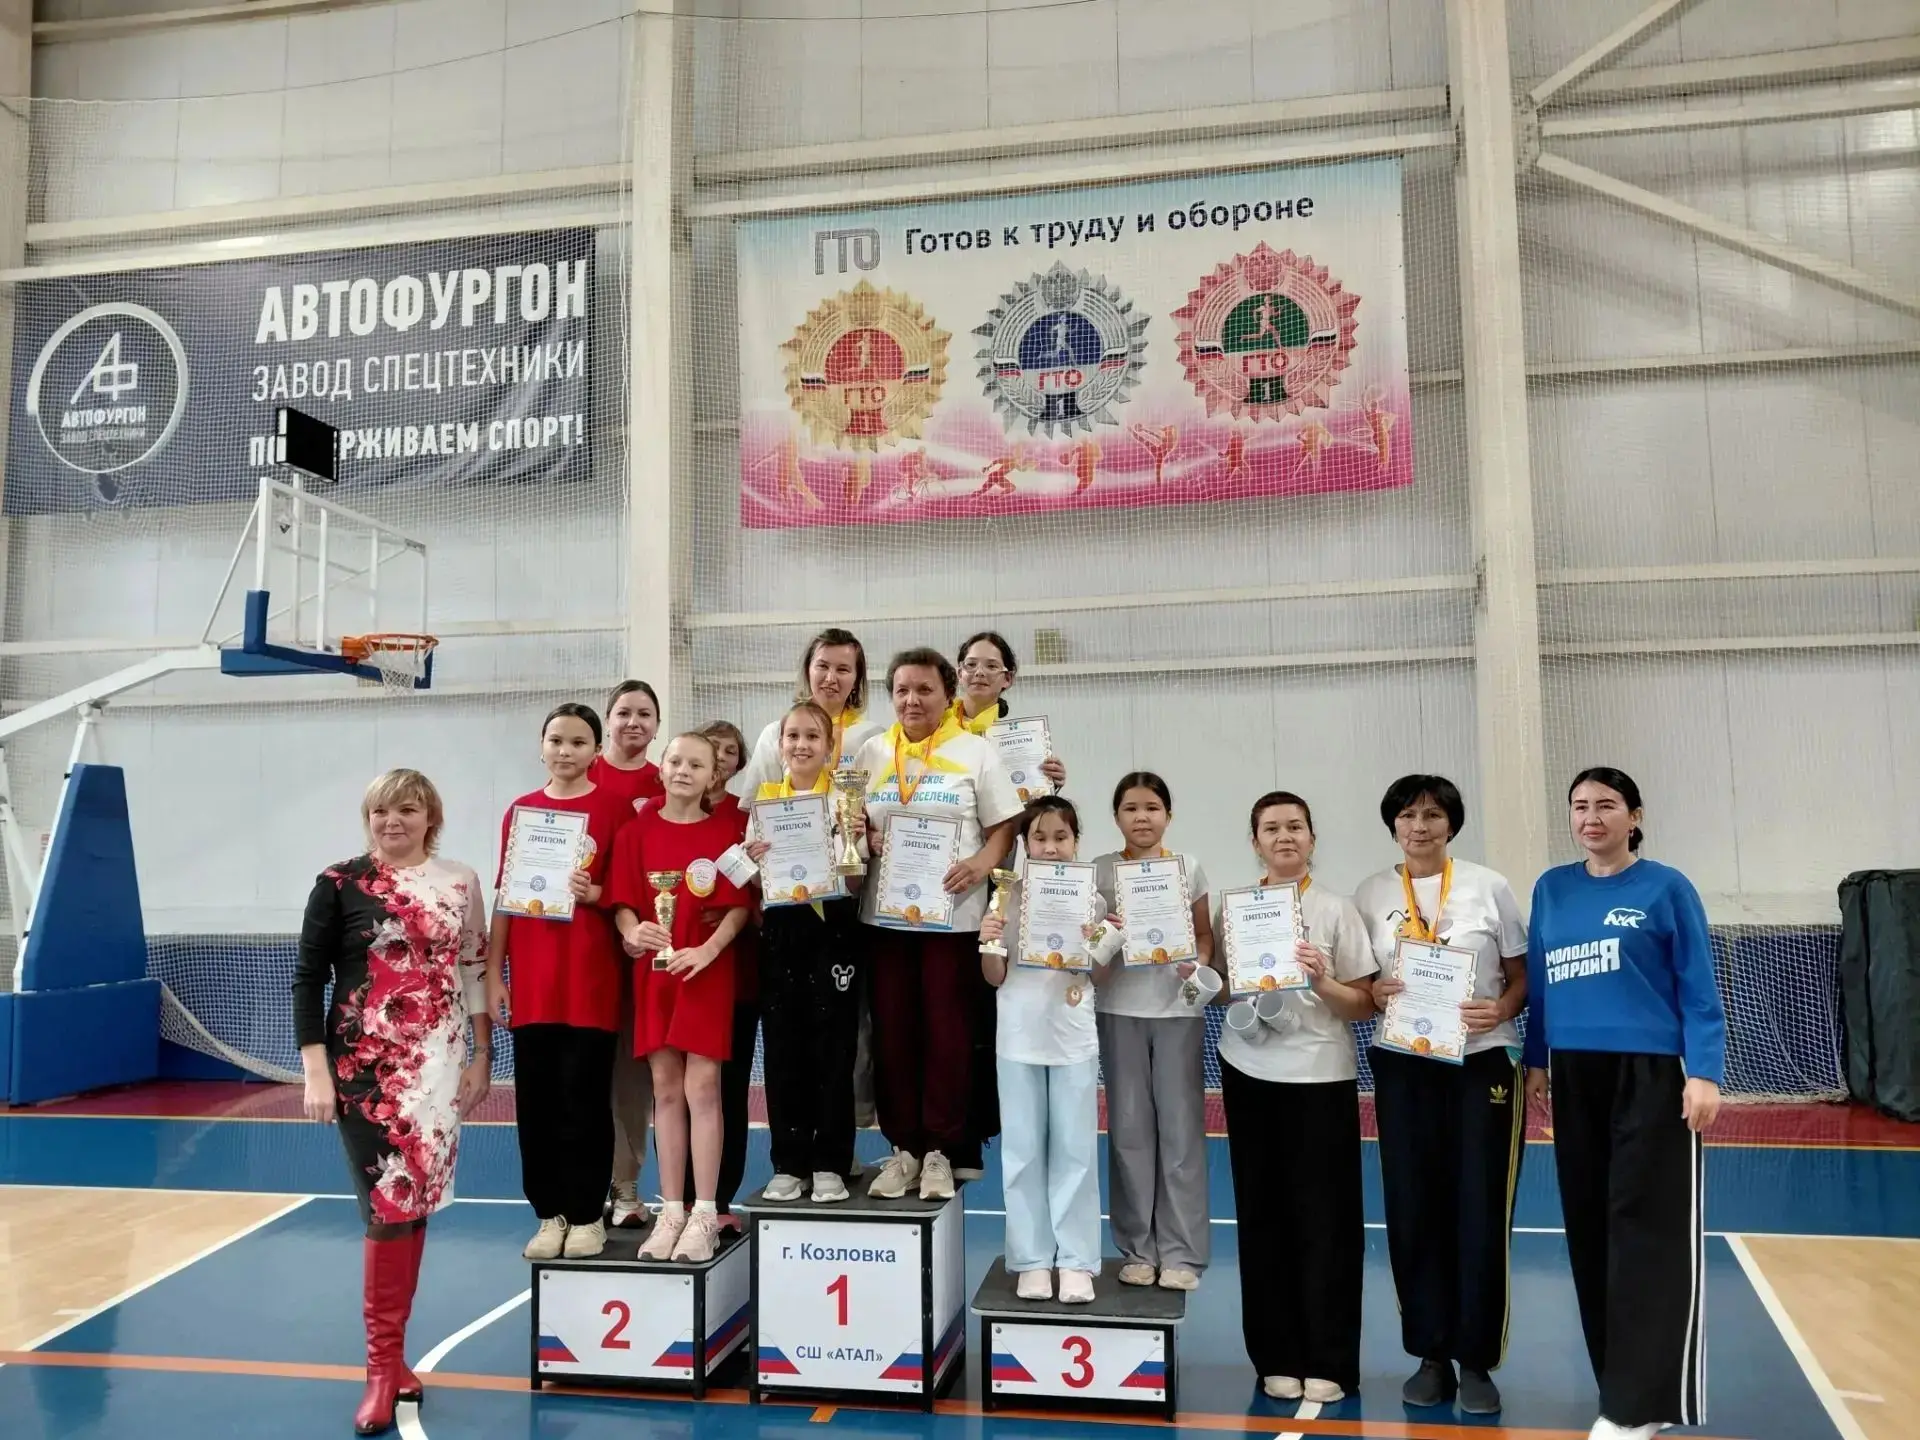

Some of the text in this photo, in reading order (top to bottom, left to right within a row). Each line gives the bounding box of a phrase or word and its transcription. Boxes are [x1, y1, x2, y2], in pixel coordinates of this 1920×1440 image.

[906, 194, 1315, 255] Готов к труду и обороне
[814, 228, 881, 276] ГТО
[254, 259, 586, 344] АВТОФУРГОН
[252, 340, 585, 402] ЗАВОД СПЕЦТЕХНИКИ
[1242, 352, 1288, 373] ГТО
[1038, 369, 1082, 390] ГТО
[61, 405, 146, 428] АВТОФУРГОН
[488, 413, 583, 452] СПОРТ!
[774, 821, 812, 832] ДИПЛОМ
[528, 834, 567, 845] ДИПЛОМ
[902, 840, 941, 851] ДИПЛОМ
[1040, 887, 1079, 897] ДИПЛОМ
[1132, 884, 1169, 894] ДИПЛОМ
[1243, 911, 1281, 922] ДИПЛОМ
[1411, 968, 1454, 983] ДИПЛОМ
[782, 1242, 897, 1263] г. Козловка
[826, 1274, 848, 1326] 1
[601, 1300, 631, 1350] 2
[796, 1345, 883, 1363] СШ «АТАЛ»
[1061, 1335, 1095, 1389] 3
